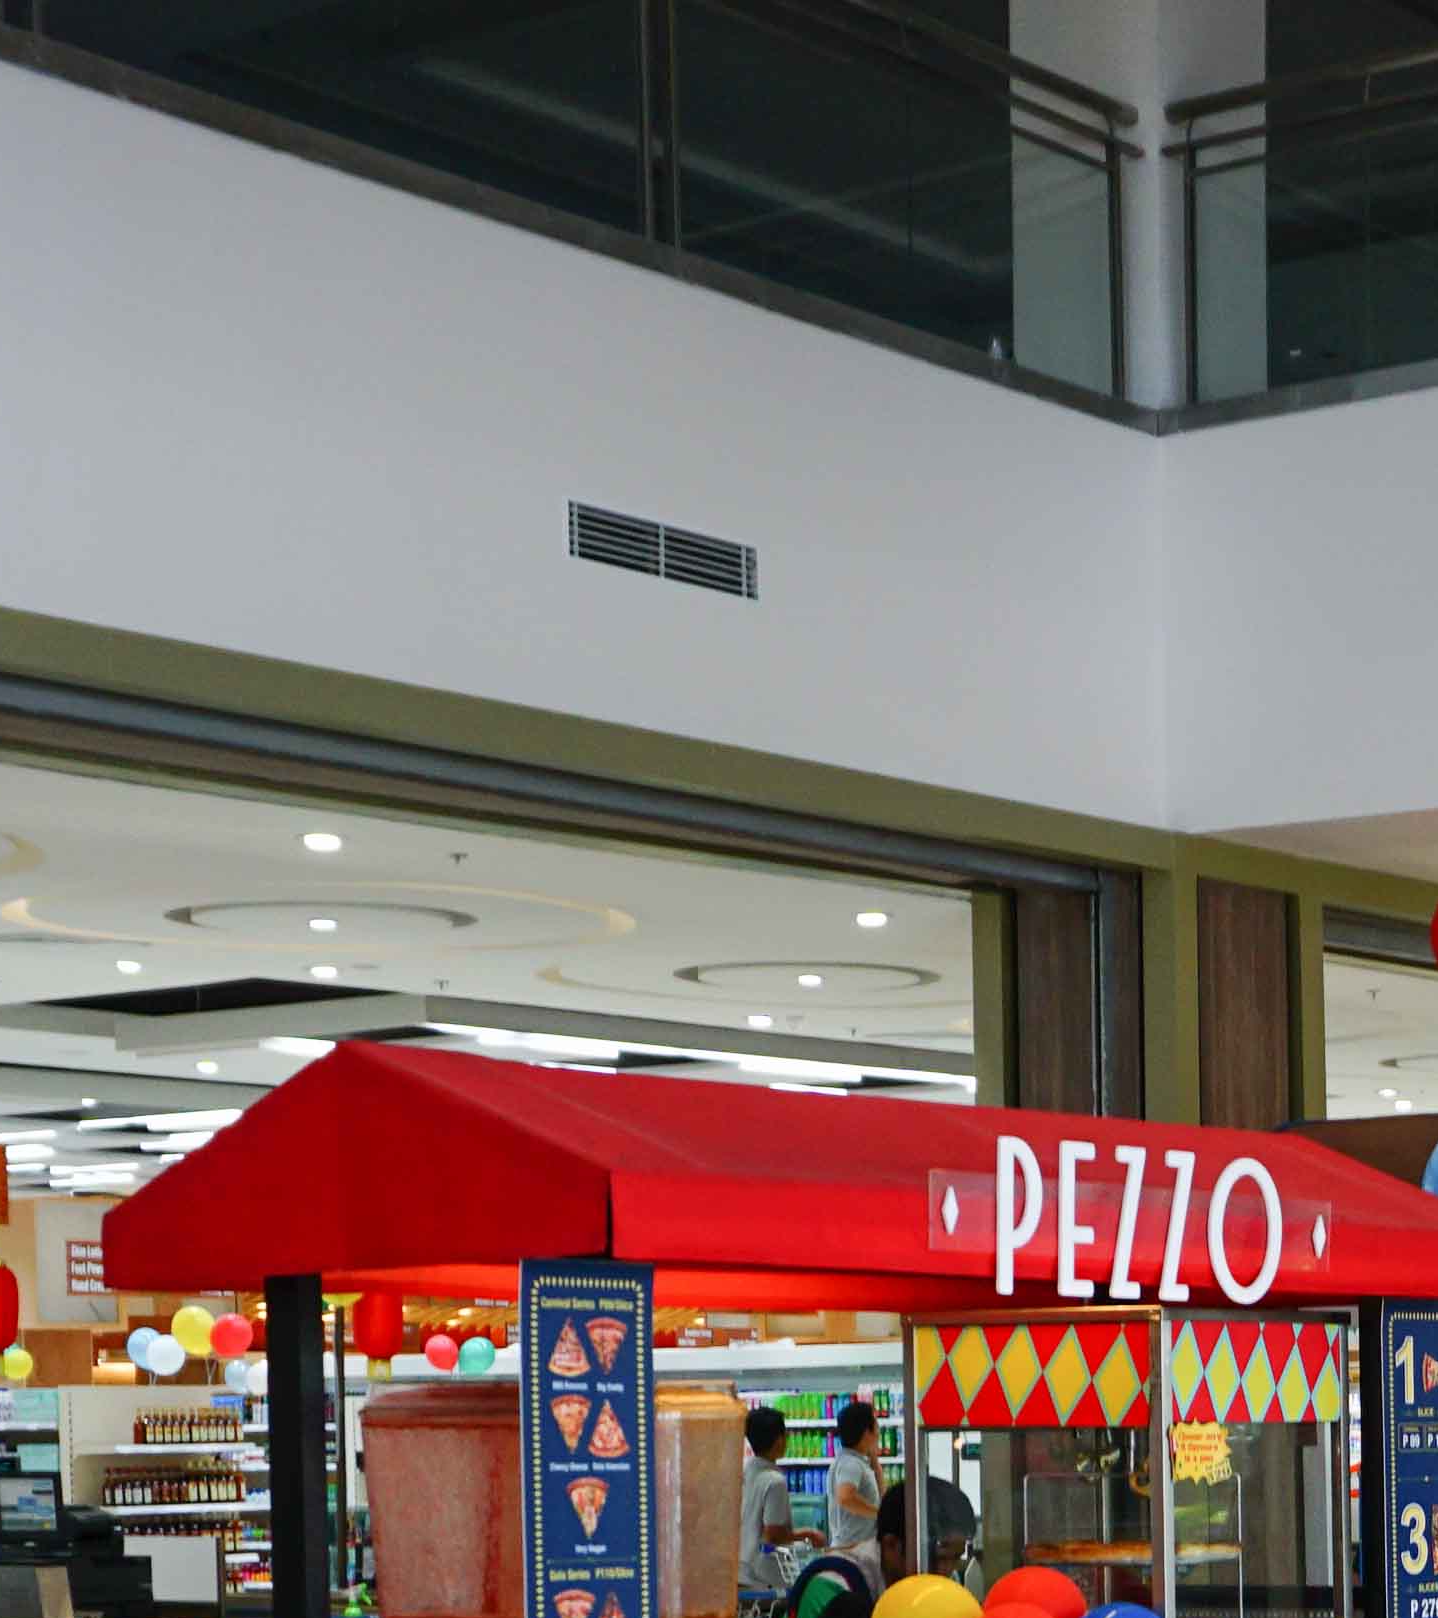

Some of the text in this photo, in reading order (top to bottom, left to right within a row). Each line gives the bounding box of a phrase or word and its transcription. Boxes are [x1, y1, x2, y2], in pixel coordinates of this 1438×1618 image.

[996, 1136, 1283, 1304] PEZZO
[1395, 1335, 1415, 1405] 1
[1427, 1433, 1434, 1449] P
[1400, 1502, 1429, 1575] 3
